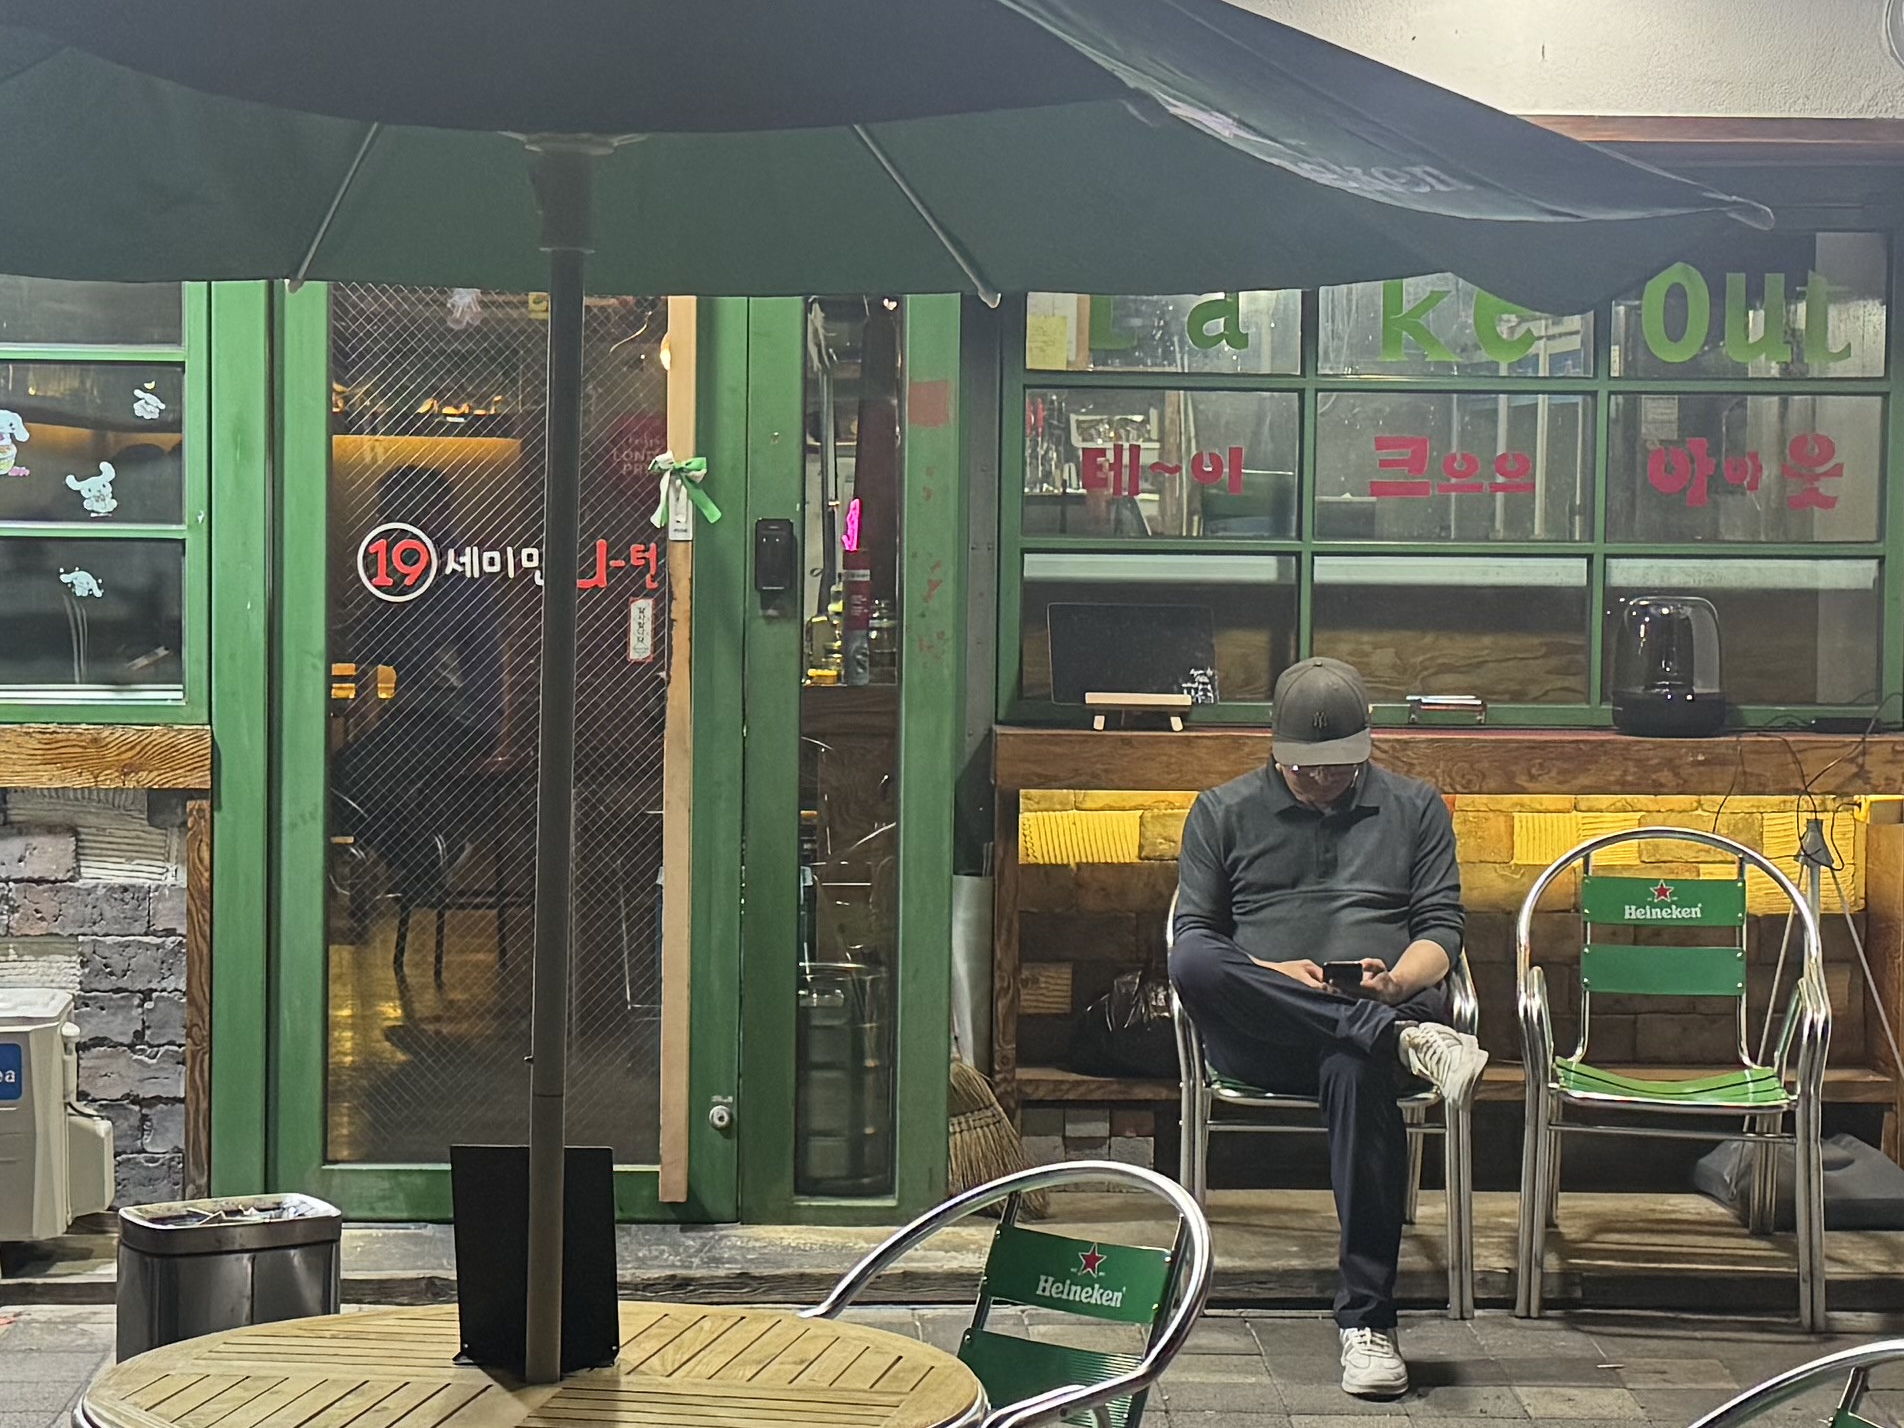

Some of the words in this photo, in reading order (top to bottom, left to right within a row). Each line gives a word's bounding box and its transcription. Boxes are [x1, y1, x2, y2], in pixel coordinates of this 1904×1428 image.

[364, 537, 430, 587] 19
[1624, 903, 1702, 920] Heineken
[1036, 1275, 1124, 1308] Heineken
